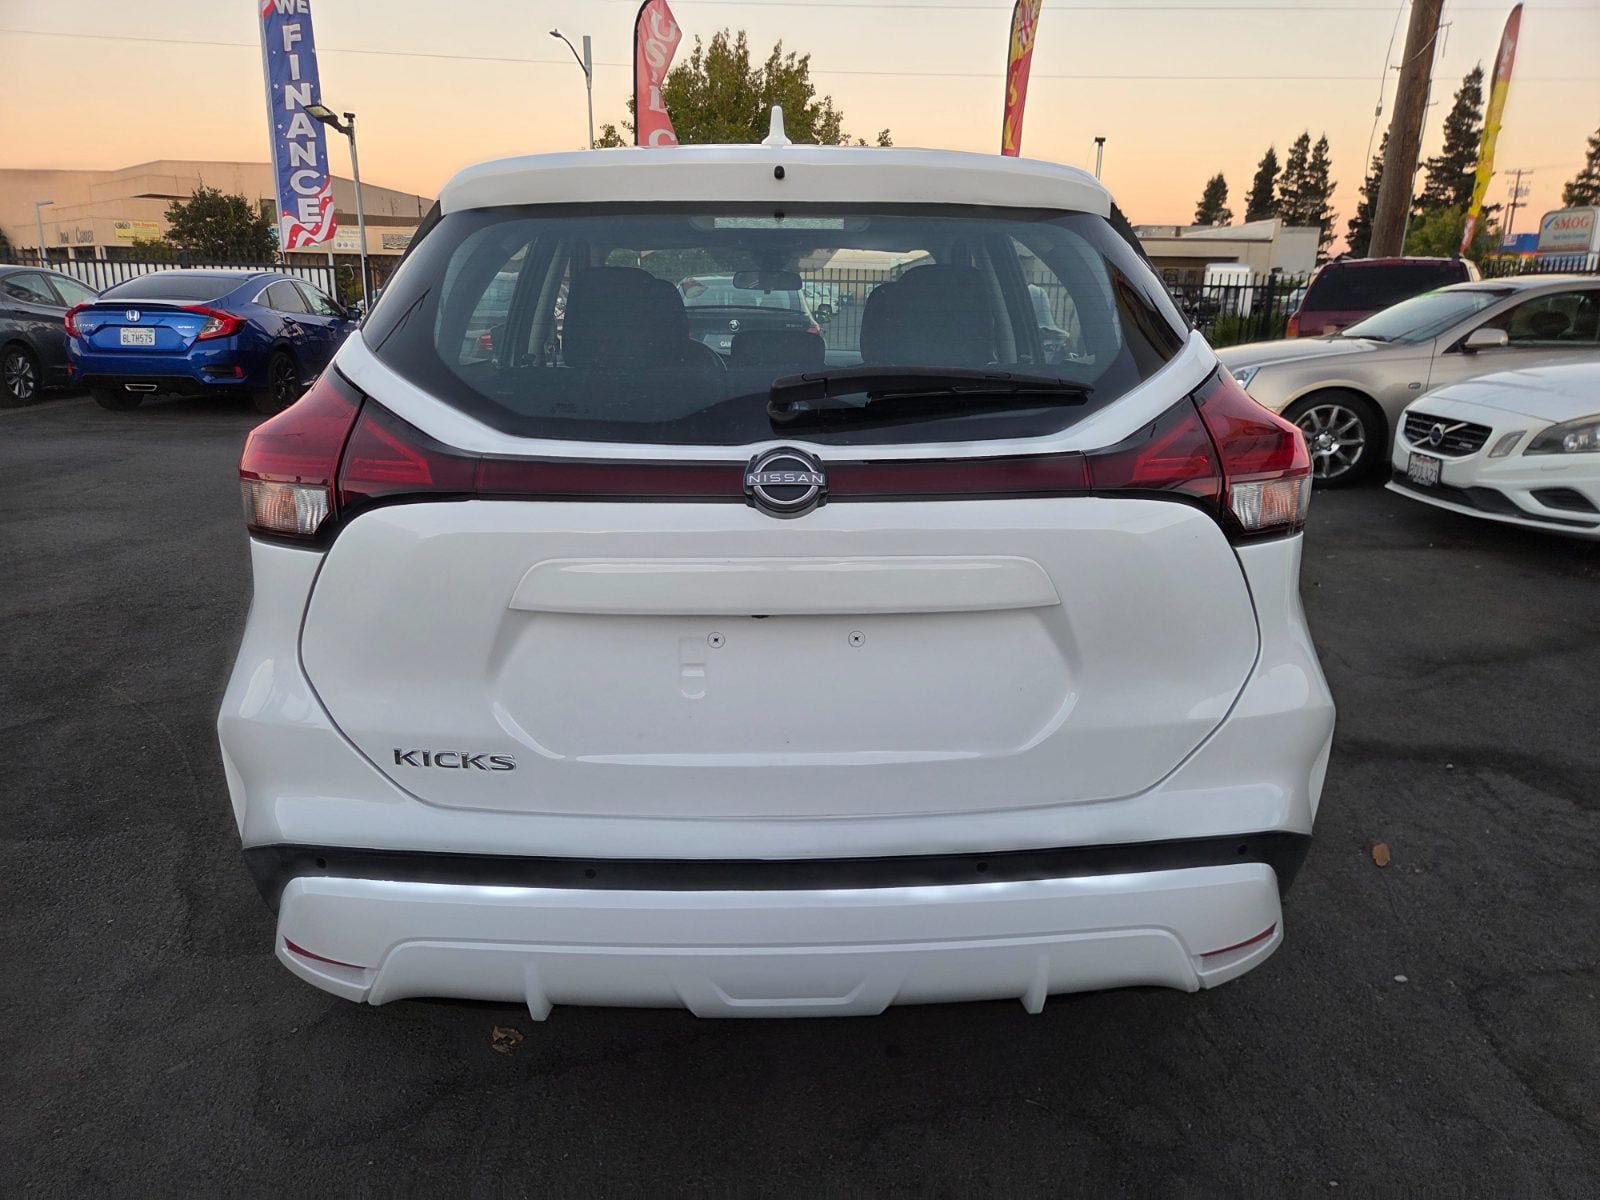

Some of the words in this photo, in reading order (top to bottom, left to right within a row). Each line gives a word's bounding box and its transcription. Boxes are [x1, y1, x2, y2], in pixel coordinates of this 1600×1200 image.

[282, 23, 322, 224] FINANCE
[749, 474, 823, 483] NISSAN
[393, 748, 516, 771] KICKS
